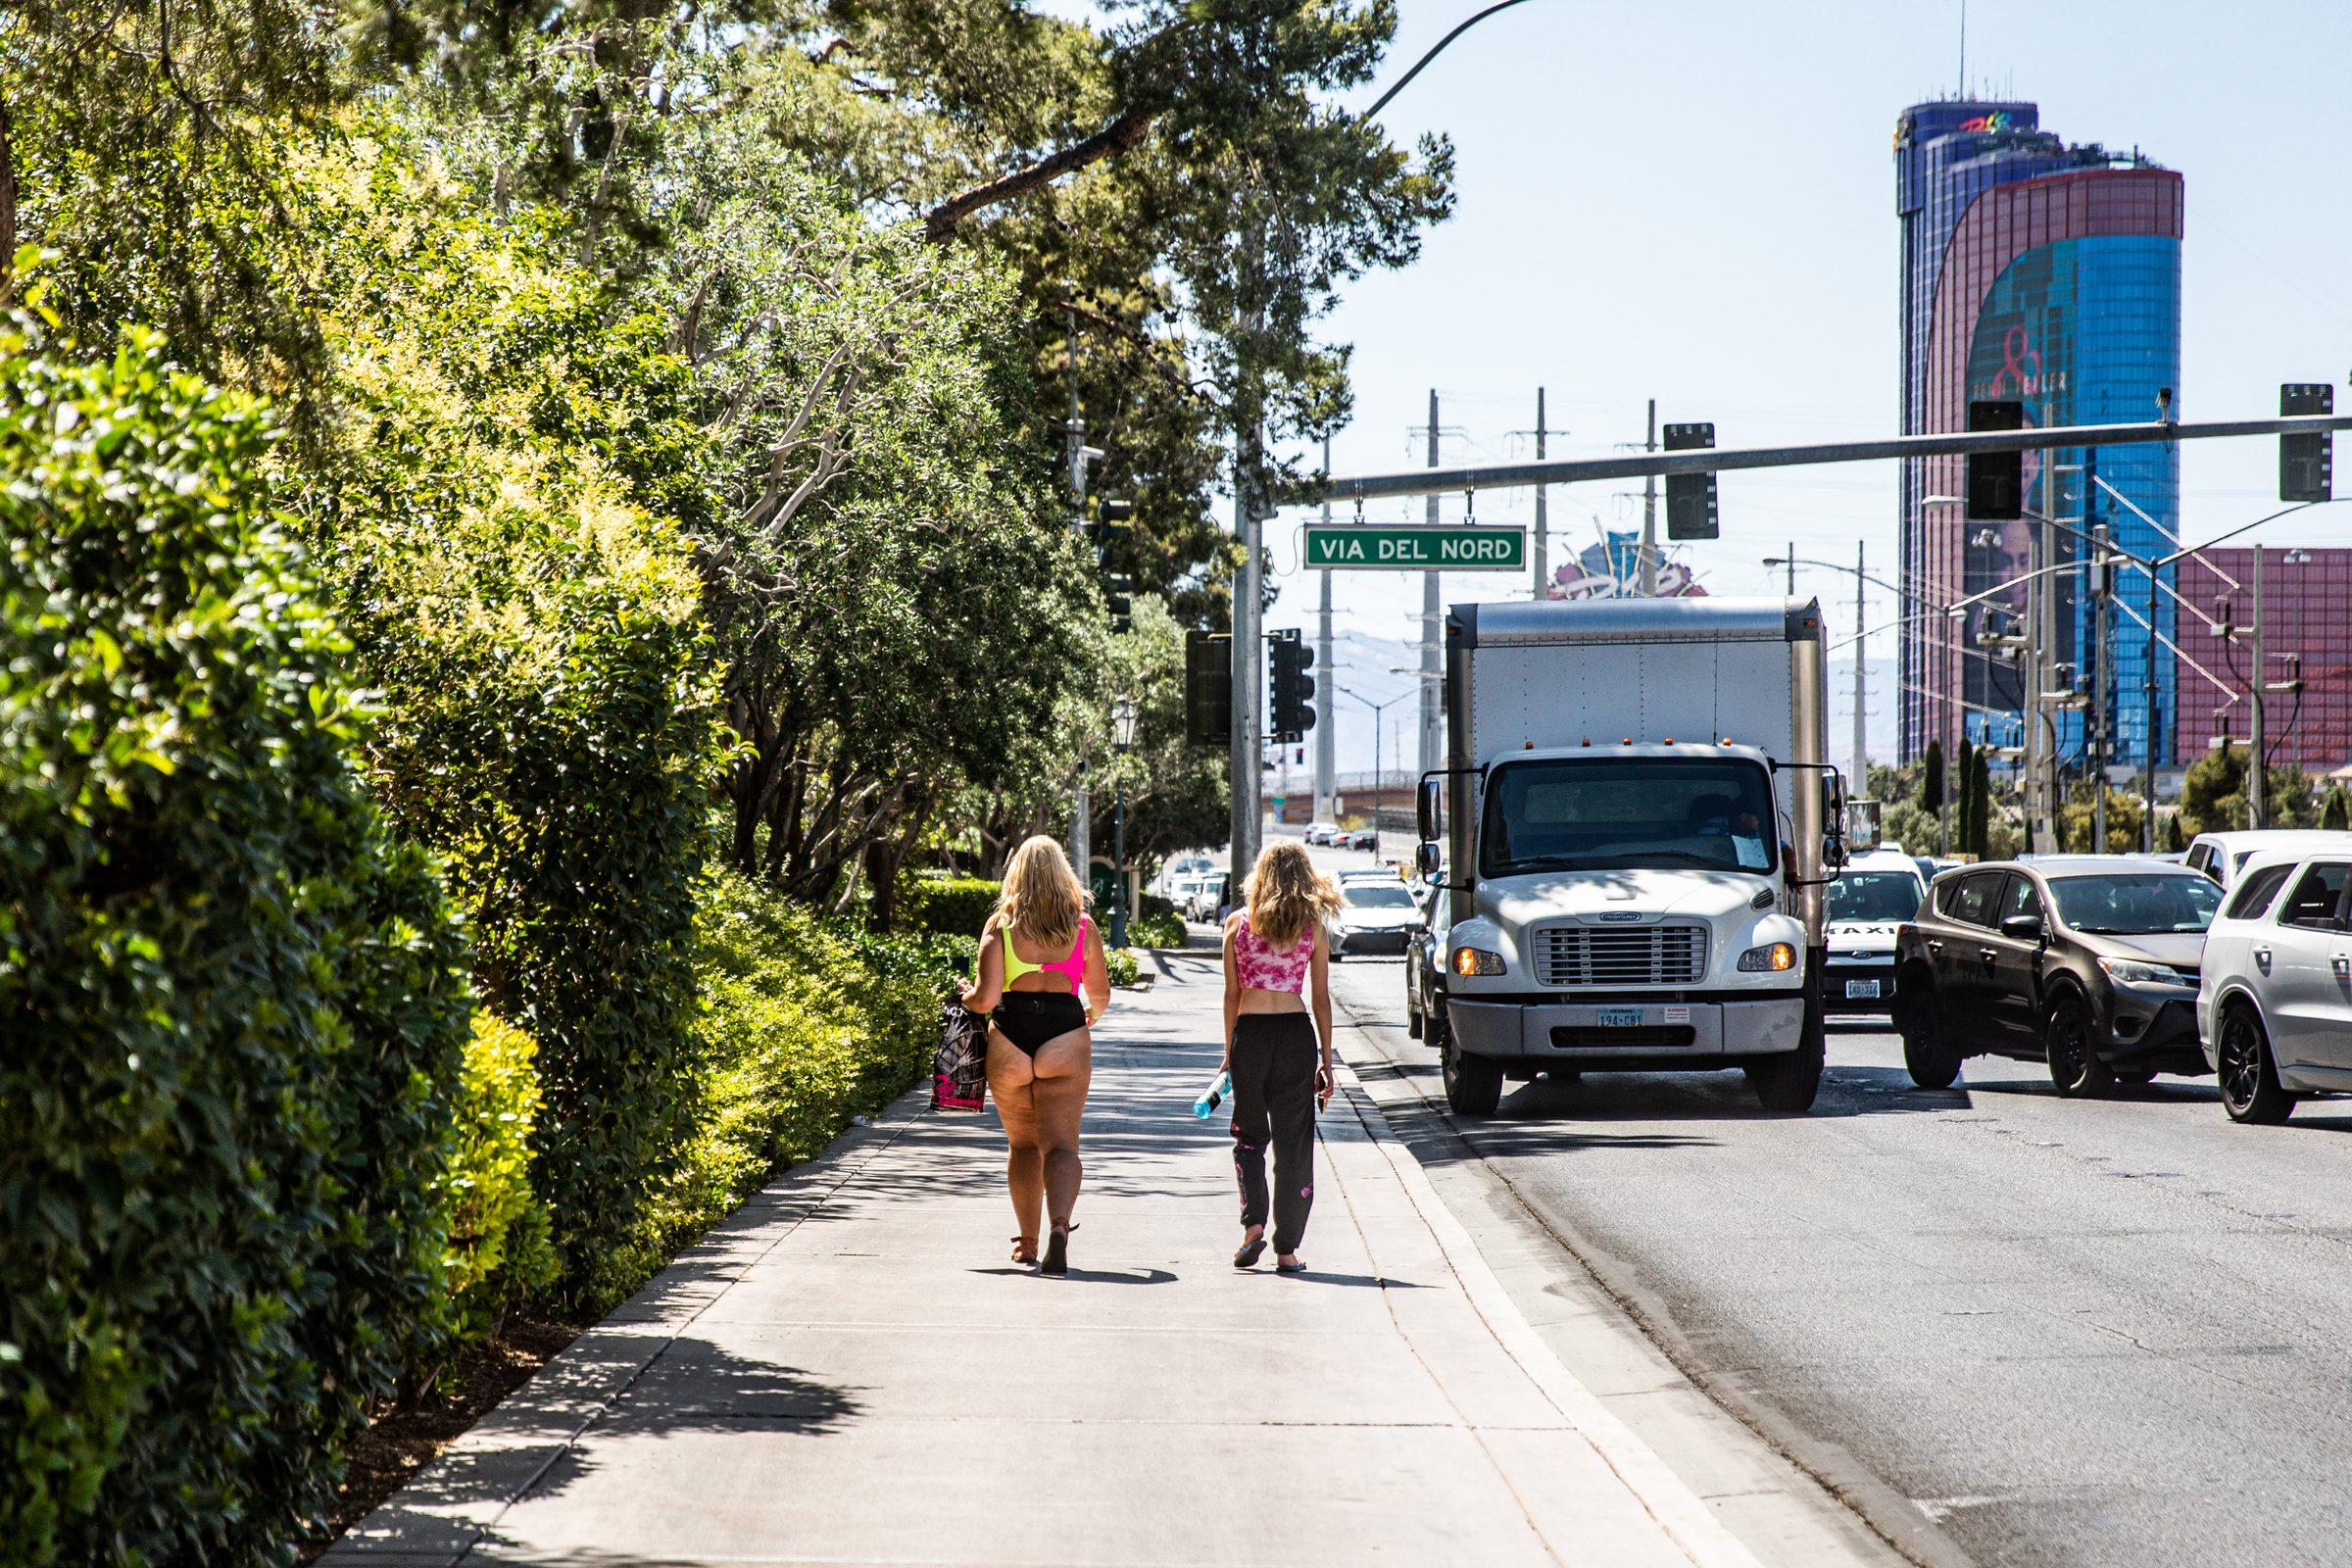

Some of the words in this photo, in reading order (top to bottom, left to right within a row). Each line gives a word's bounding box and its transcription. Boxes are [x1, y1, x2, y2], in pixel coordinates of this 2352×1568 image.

[1320, 539, 1364, 560] VIA
[1378, 539, 1428, 560] DEL
[1441, 539, 1511, 560] NORD
